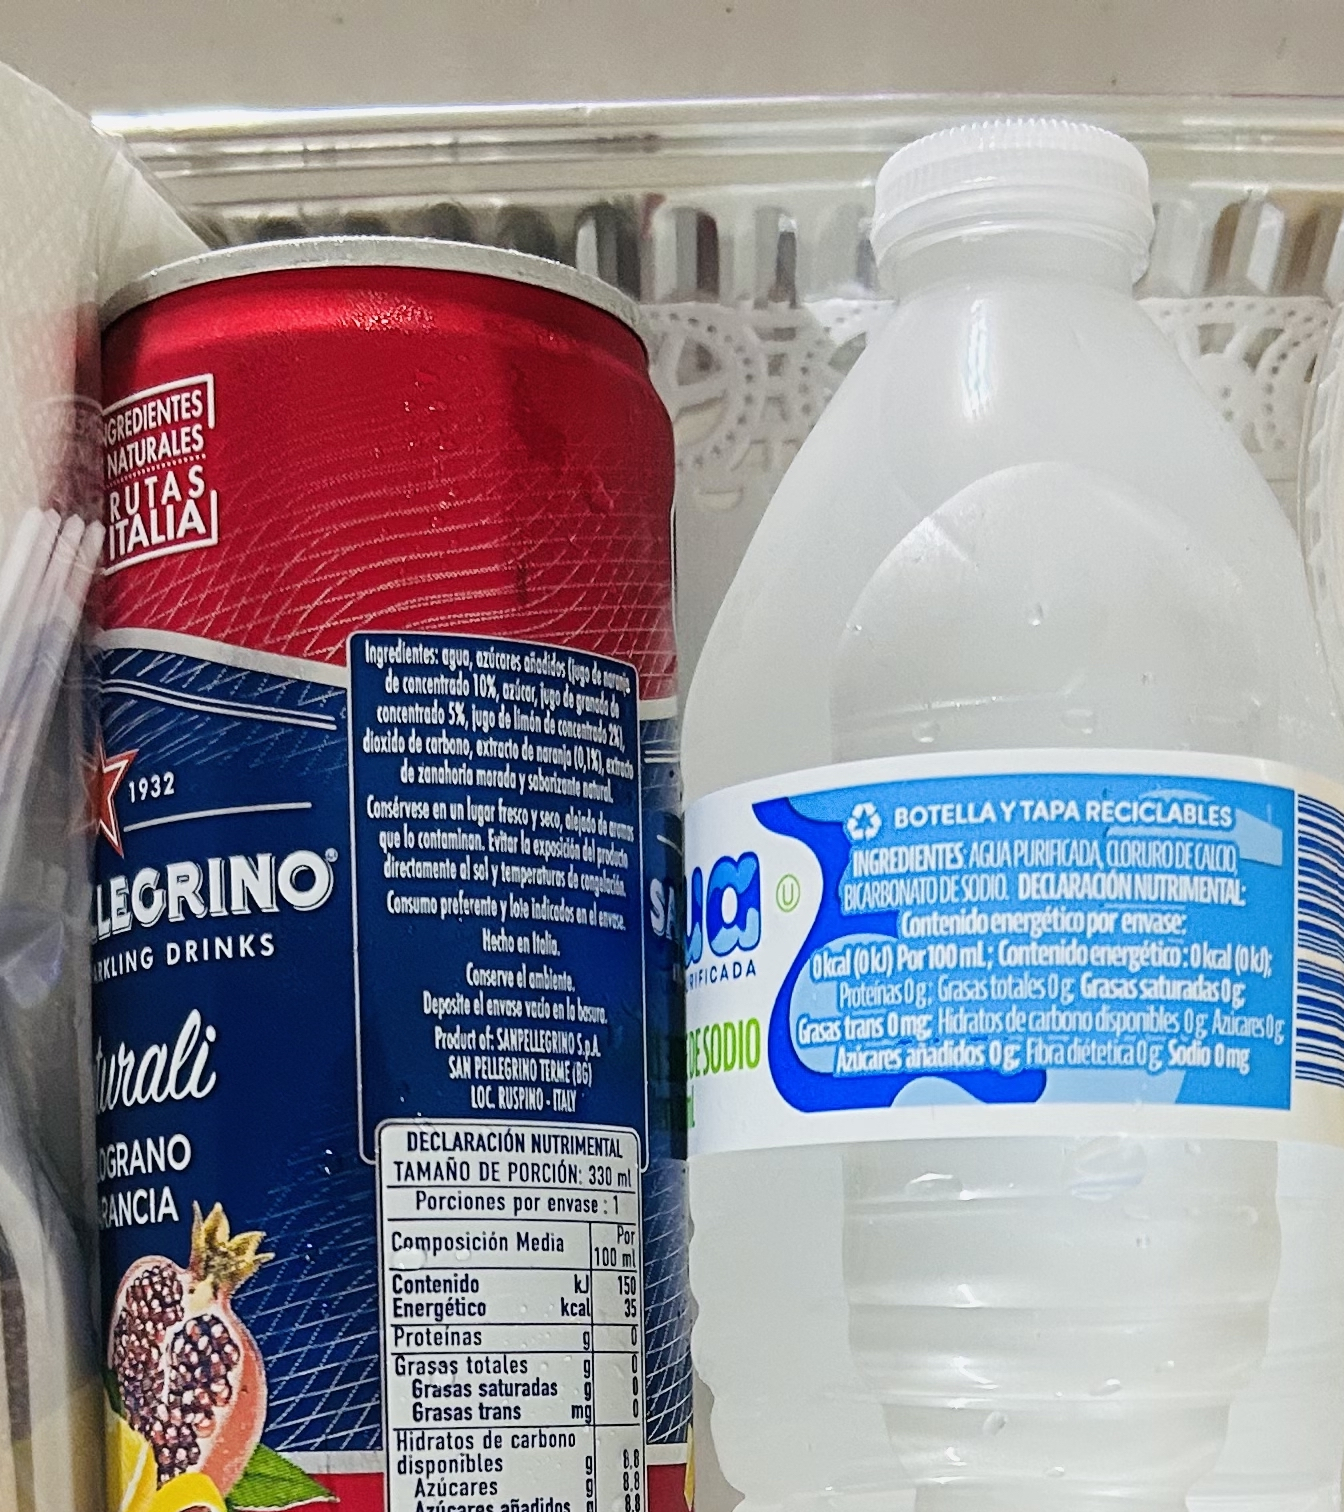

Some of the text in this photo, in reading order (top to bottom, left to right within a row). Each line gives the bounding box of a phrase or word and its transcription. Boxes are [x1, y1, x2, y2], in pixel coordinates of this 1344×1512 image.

[102, 390, 203, 448] GREDIENTES
[107, 424, 204, 479] NATURALES
[110, 465, 205, 523] RUTAS
[109, 499, 206, 561] ITALIA
[365, 637, 473, 671] Ingredientes: agua,
[385, 666, 499, 703] de concentrado 10%,
[377, 698, 541, 732] concentrado jugo de limón
[408, 728, 534, 761] de carbono, de
[128, 771, 175, 804] 1932
[400, 757, 516, 789] de zanahoria morada
[367, 794, 528, 827] Consérvese en un lugar fresco
[895, 800, 1232, 829] BOTELLA Y TAPA RECICLABLES
[379, 828, 485, 854] que contaminan.
[969, 838, 1193, 869] AGUA PURIFICADA, CLORURO DE
[384, 852, 565, 888] directamente temperaturas
[97, 849, 335, 941] LEGRINO
[387, 889, 497, 920] Consumo preferente
[844, 869, 1132, 912] BICARBONATO DE DECLARACIÓN
[901, 904, 1118, 939] Contenido energético por
[482, 927, 514, 952] Hecho
[929, 938, 1182, 972] 100 Contenido energético
[94, 933, 275, 982] ARKLING DRINKS
[466, 962, 513, 987] Conserve
[687, 960, 756, 992] RIFICADA
[839, 971, 1219, 1008] Proteínas Grasas totales Grasas saturadas
[486, 999, 523, 1018] envase
[435, 1025, 574, 1055] Product SANPELLEGRINO
[798, 1004, 1092, 1045] Grasas trans Hidratos carbono
[96, 1008, 217, 1115] turali
[703, 1018, 761, 1076] SODIO
[906, 1039, 1211, 1070] añadidos Sodio
[449, 1055, 570, 1084] SAN PELLEGRINO TERME
[498, 1086, 577, 1113] RUSPINO ITALY
[98, 1133, 192, 1181] OGRANO
[406, 1128, 623, 1158] DECLARACIÓN NUTRIMENTAL
[394, 1156, 632, 1188] TAMAÑO DE PORCIÓN: 330 ml
[100, 1186, 180, 1229] RANCIA
[415, 1191, 598, 1216] Porciones por envase
[391, 1232, 565, 1255] Composición Media
[617, 1226, 636, 1245] Por
[595, 1248, 636, 1268] 100 ml
[392, 1274, 636, 1296] Contenido 150
[393, 1297, 637, 1321] Energético kcal 35
[394, 1326, 482, 1347] Proteínas
[394, 1356, 528, 1376] Grasas totales
[412, 1377, 558, 1398] Grasas saturadas
[412, 1402, 592, 1424] Grasas trans mg
[396, 1430, 576, 1450] Hidratos de carbono
[397, 1454, 503, 1478] disponibles
[414, 1479, 498, 1497] Azúcares
